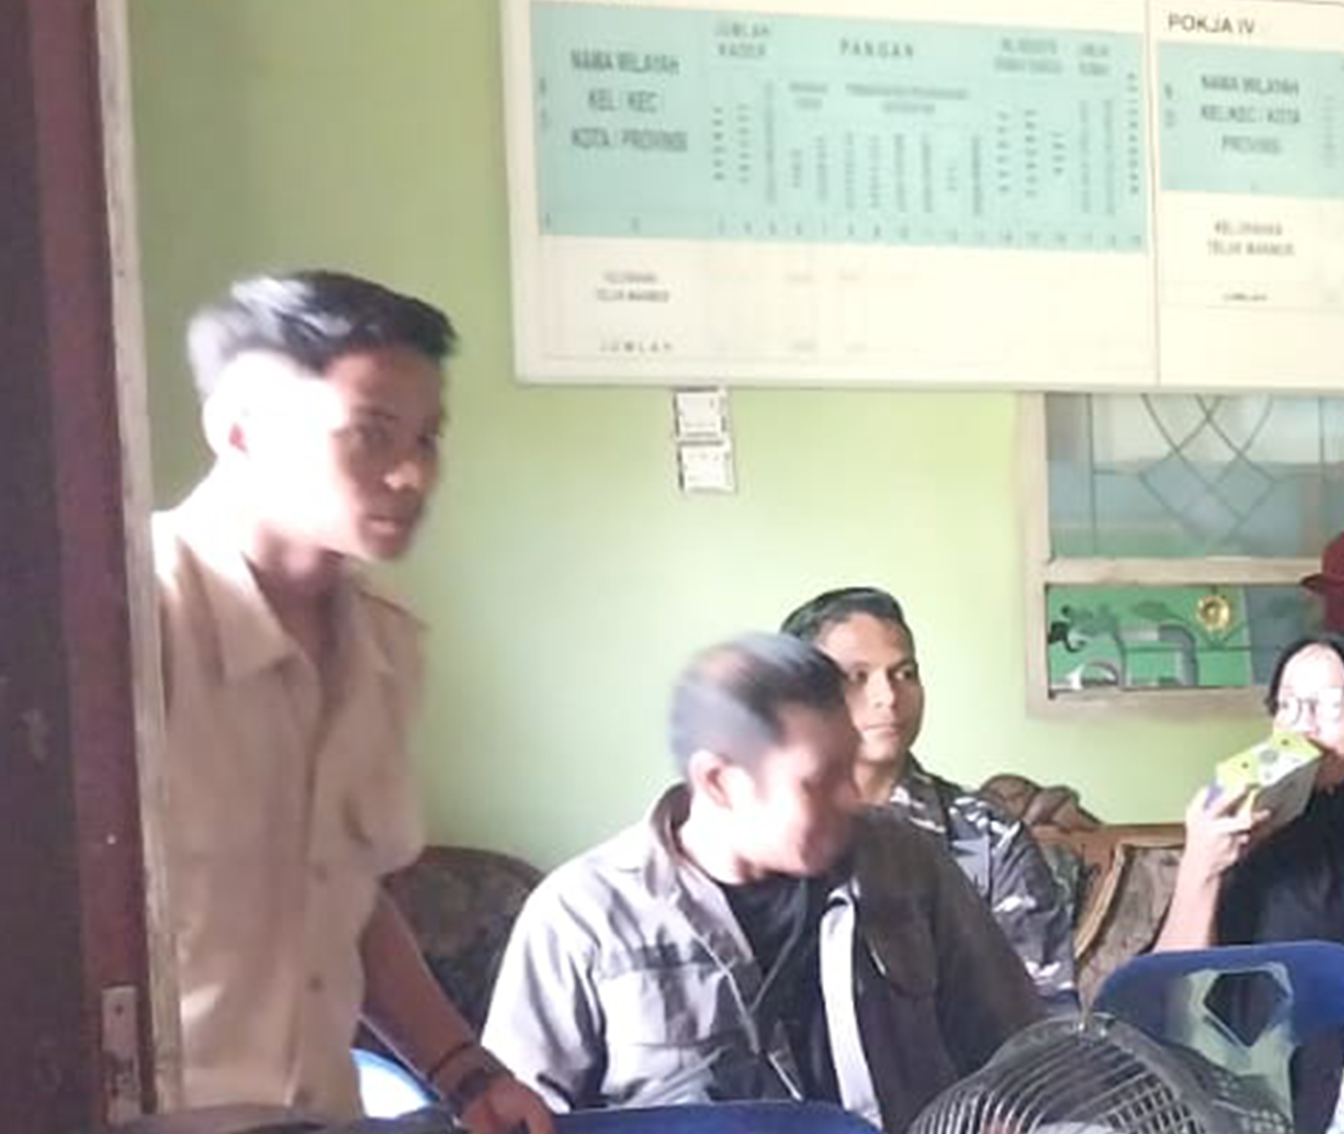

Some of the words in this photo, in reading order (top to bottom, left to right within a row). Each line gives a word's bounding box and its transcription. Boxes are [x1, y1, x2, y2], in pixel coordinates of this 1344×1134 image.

[1168, 13, 1234, 34] POKJA
[1238, 17, 1256, 34] IV
[571, 49, 613, 71] NAMA
[617, 51, 681, 76] WILAYAH
